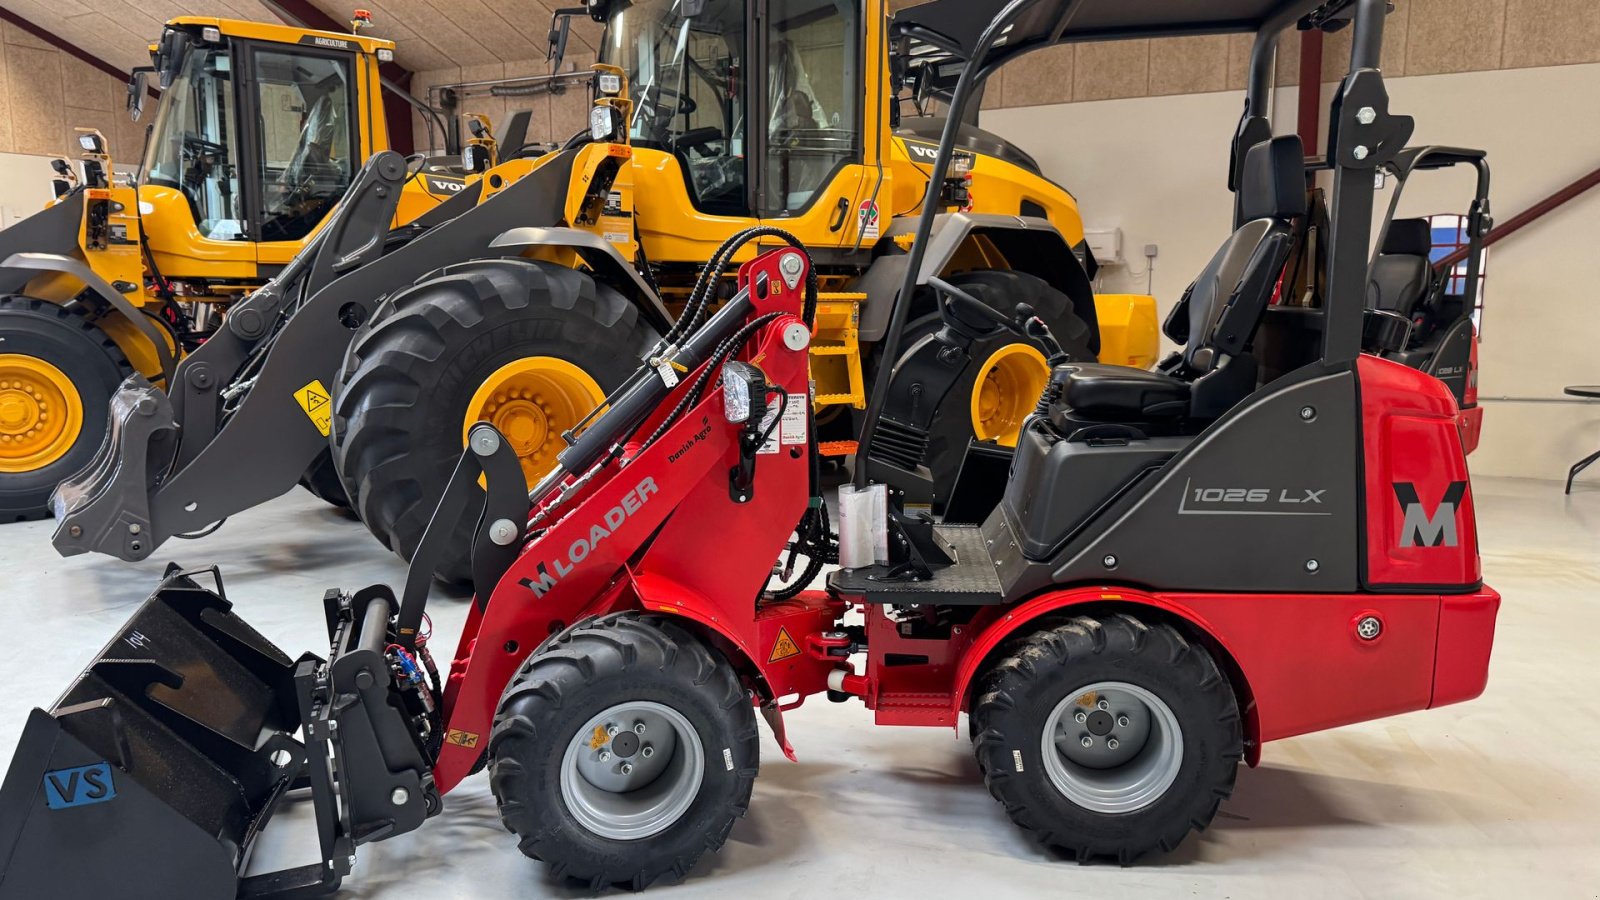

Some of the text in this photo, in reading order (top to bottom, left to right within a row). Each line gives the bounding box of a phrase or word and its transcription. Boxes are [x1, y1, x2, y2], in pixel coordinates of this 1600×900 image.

[315, 36, 348, 49] AGRICULTURE
[911, 145, 941, 158] VO
[668, 425, 712, 463] Danish Agro
[1195, 488, 1326, 503] 1026 LX
[553, 476, 659, 578] LOADER
[48, 768, 107, 803] VS
